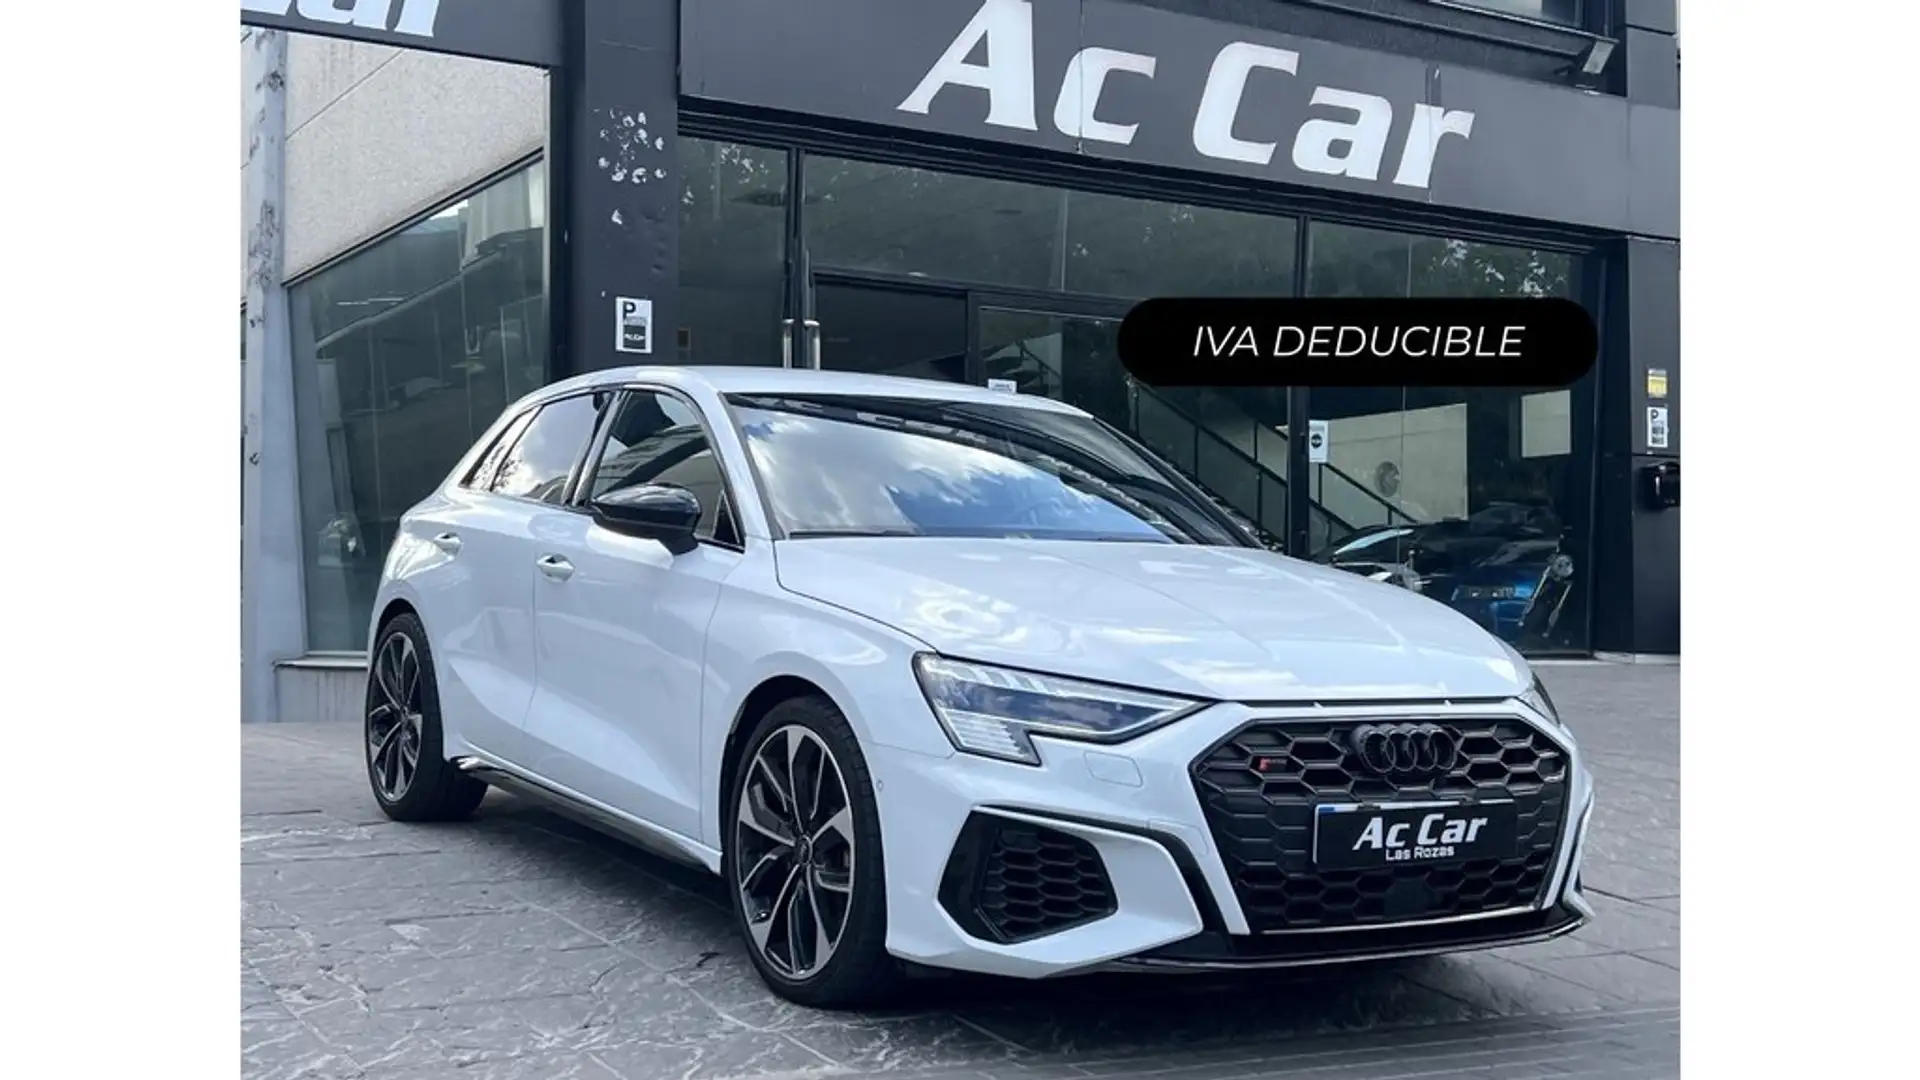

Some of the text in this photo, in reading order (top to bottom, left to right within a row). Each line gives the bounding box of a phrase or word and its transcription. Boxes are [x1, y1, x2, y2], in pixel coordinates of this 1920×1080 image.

[898, 0, 1475, 189] Ac Car
[622, 301, 636, 320] P
[1353, 813, 1488, 850] Ac Car
[1385, 845, 1455, 861] Las Rozas
